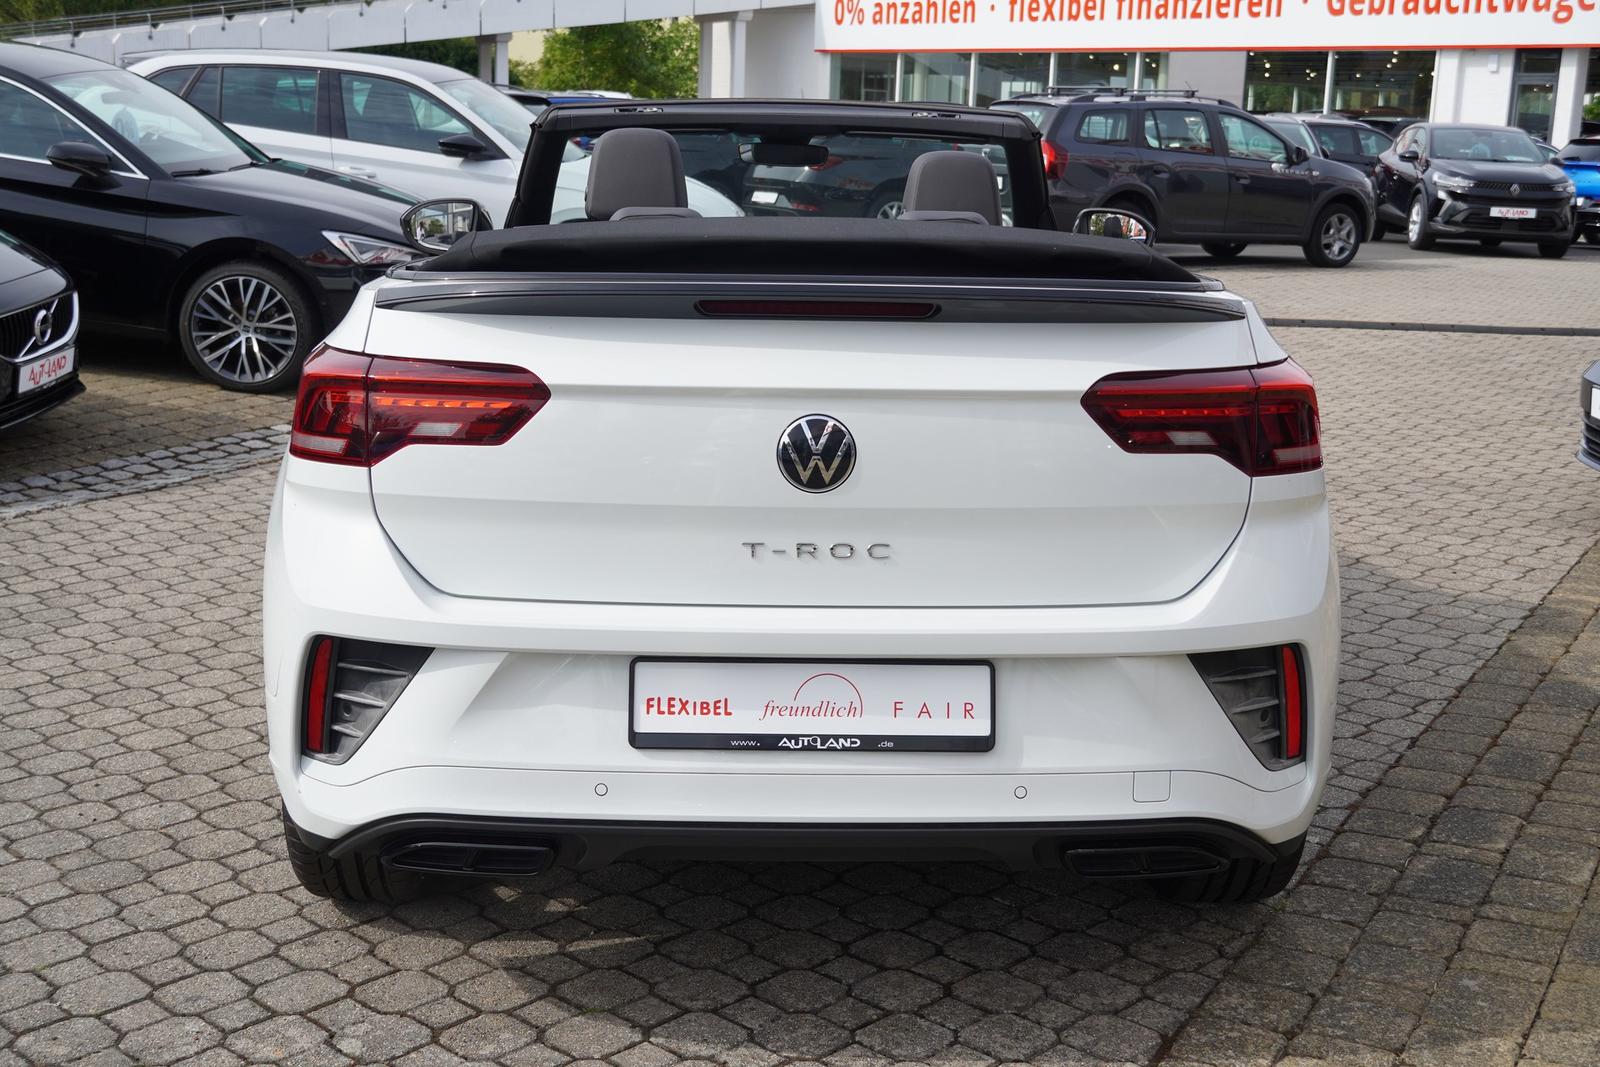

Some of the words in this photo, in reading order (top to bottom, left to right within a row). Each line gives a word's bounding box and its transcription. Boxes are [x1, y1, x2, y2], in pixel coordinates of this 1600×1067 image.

[834, 0, 865, 25] 0%
[871, 0, 977, 25] anzahlen
[1008, 0, 1106, 23] flexibel
[741, 542, 892, 560] T-ROC
[646, 696, 733, 716] FLEXIBEL
[758, 699, 857, 721] freundlich
[894, 701, 976, 719] FAIR
[777, 735, 862, 750] AUTOLAND
[877, 739, 894, 747] .de
